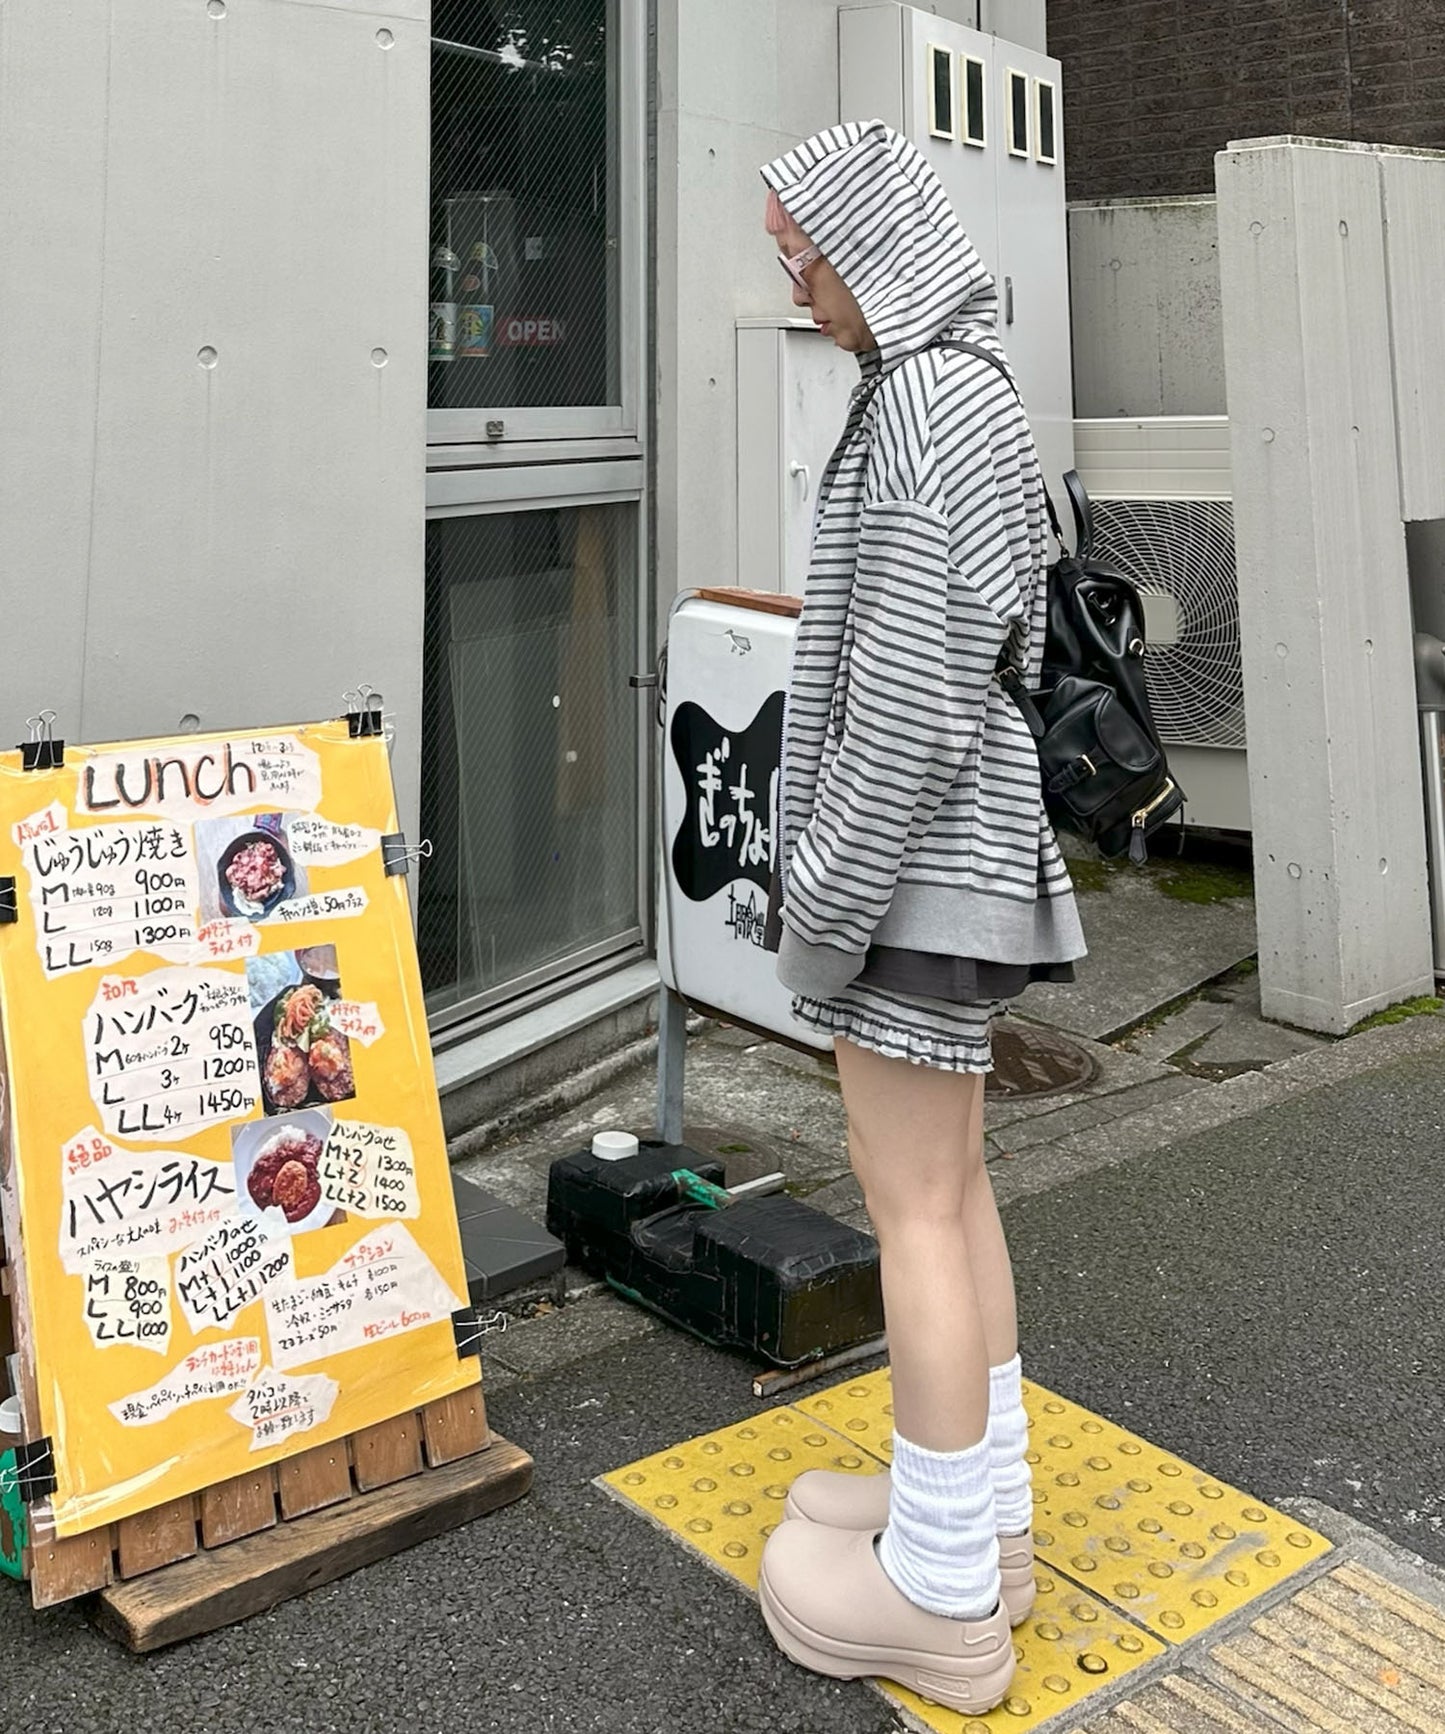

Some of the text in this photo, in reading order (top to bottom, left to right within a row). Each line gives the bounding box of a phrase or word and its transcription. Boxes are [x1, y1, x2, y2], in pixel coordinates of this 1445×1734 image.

[507, 319, 565, 341] OPEN
[695, 736, 779, 874] ぎっちょ
[33, 826, 188, 877] じゅうじゅう焼き
[42, 882, 69, 905] M
[135, 869, 186, 895] 900円
[44, 911, 67, 934] L
[135, 897, 186, 918] 1100円
[46, 942, 93, 971] LL
[135, 925, 191, 945] 1300円
[94, 982, 211, 1045] ハンバーグ
[95, 1048, 125, 1076] M
[209, 1023, 253, 1051] 950円
[103, 1082, 126, 1105] L
[203, 1057, 256, 1080] 1200円
[118, 1103, 165, 1134] LL
[200, 1089, 256, 1116] 1450円
[377, 1155, 414, 1177] 1300円
[374, 1174, 405, 1191] 1400
[68, 1160, 235, 1239] ハヤシライス
[375, 1194, 407, 1212] 1500
[226, 1233, 269, 1264] 1000円
[233, 1249, 262, 1278] 1100
[343, 1240, 395, 1268] オプション
[259, 1252, 290, 1284] 1200
[88, 1273, 167, 1301] M 800円
[87, 1298, 163, 1319] L 900
[96, 1318, 169, 1340] LL 1000
